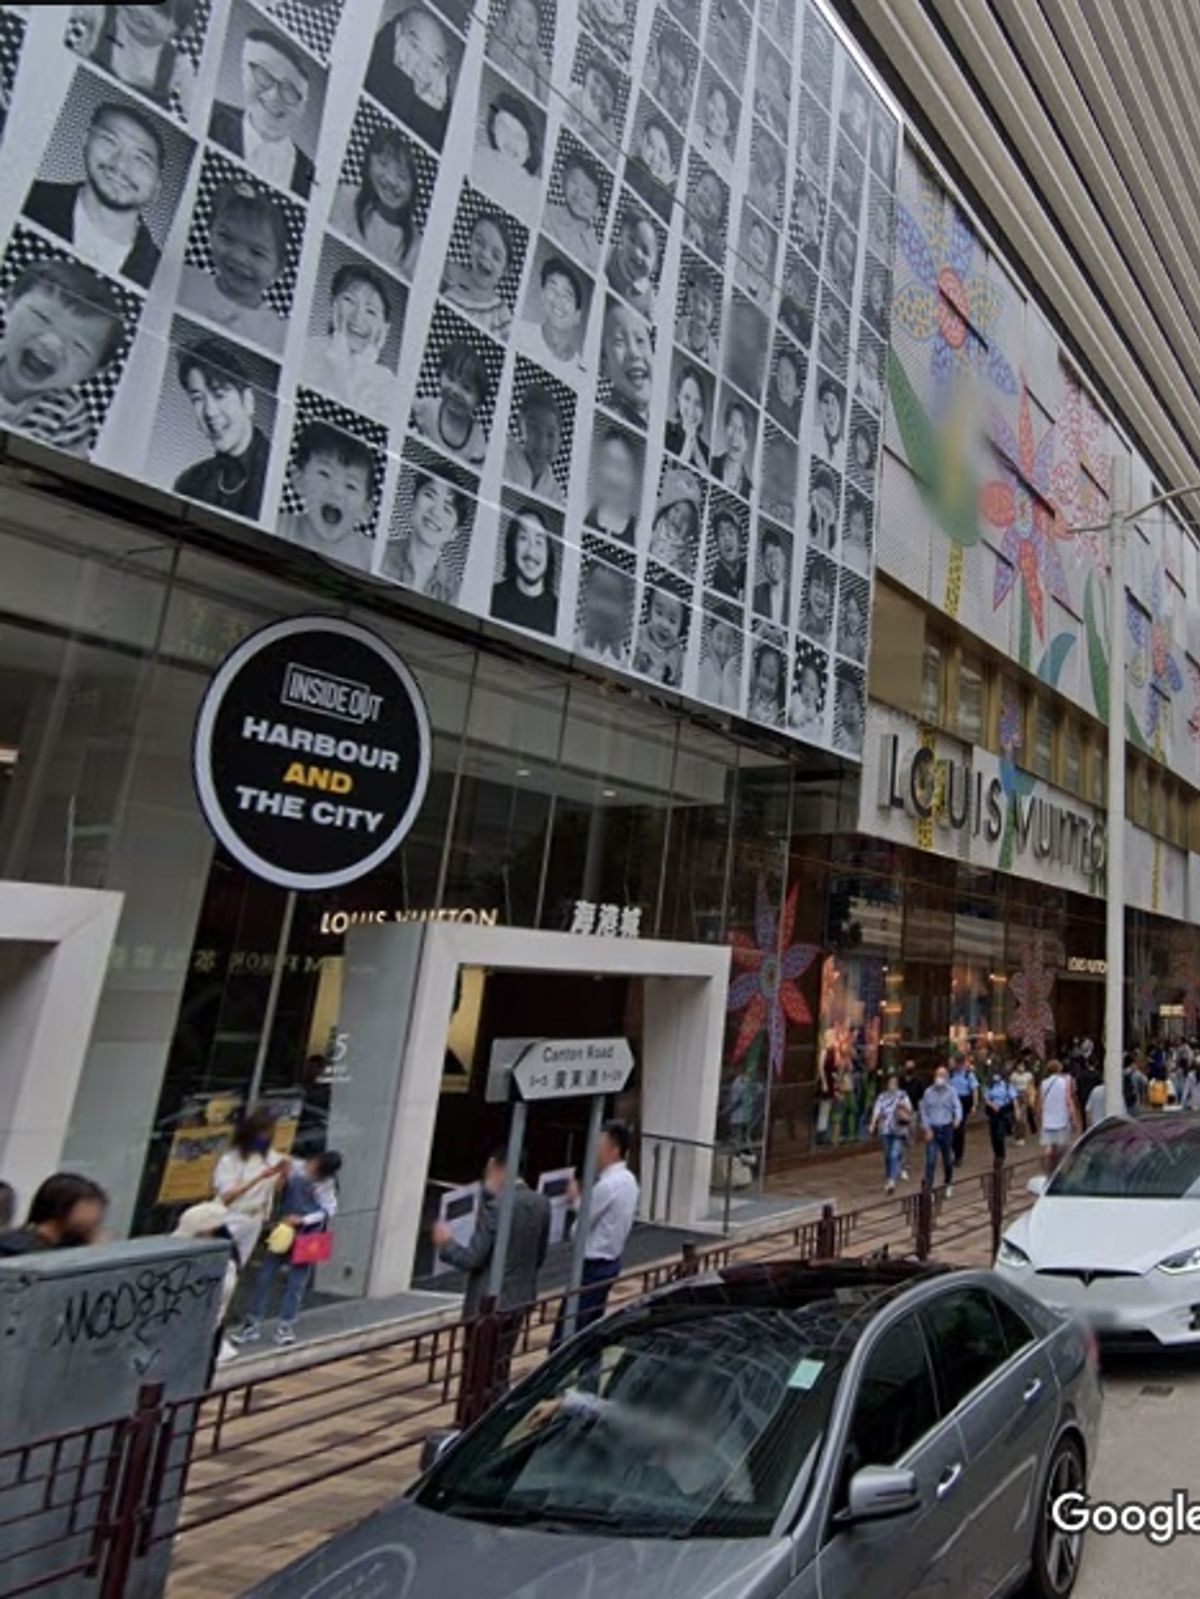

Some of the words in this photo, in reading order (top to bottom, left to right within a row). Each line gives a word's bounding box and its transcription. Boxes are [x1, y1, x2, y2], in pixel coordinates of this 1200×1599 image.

[288, 671, 348, 714] INSIDE
[348, 688, 384, 722] OUT
[241, 715, 400, 773] HARBOUR
[283, 761, 353, 794] AND
[235, 784, 306, 819] THE
[311, 801, 385, 833] CITY
[880, 734, 1002, 843] LOUIS
[1012, 792, 1108, 876] VUITTO
[543, 1046, 583, 1063] Canton
[587, 1044, 614, 1059] Road
